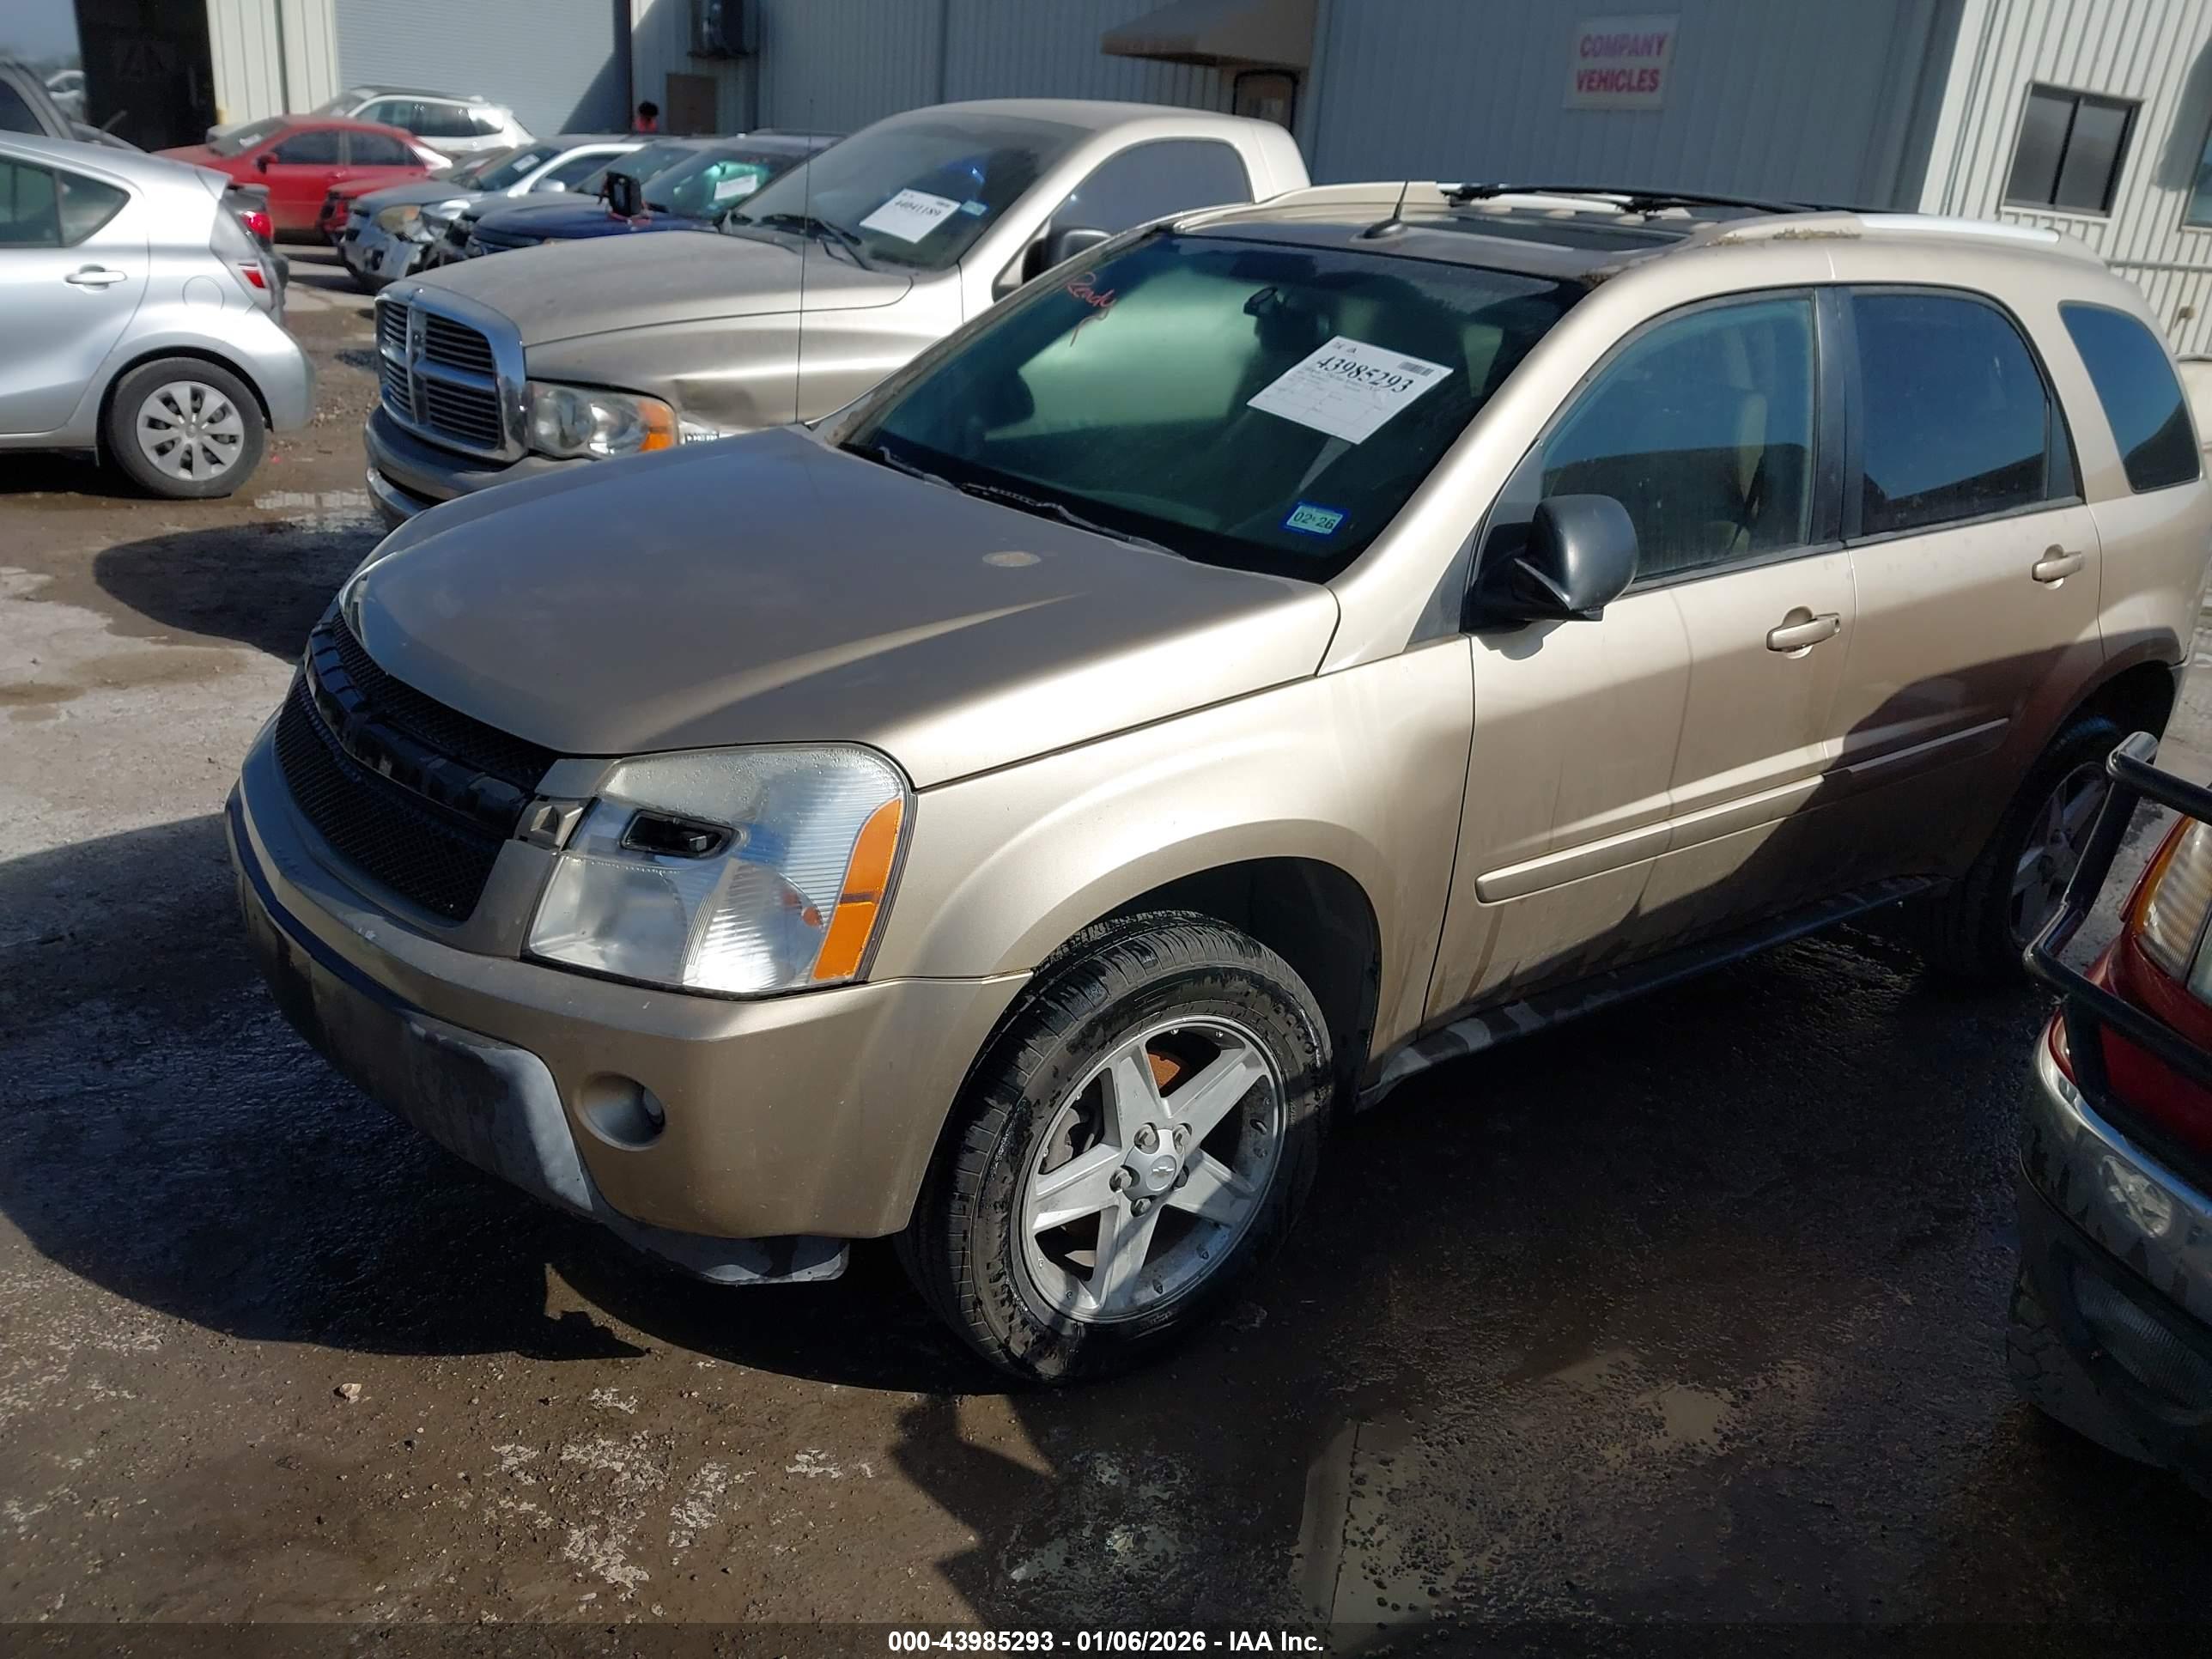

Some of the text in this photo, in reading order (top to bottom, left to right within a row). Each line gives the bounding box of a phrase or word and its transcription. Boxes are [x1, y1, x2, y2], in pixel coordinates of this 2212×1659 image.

[1580, 33, 1668, 58] COMPANY
[1576, 69, 1659, 92] VEHICLES
[1316, 356, 1416, 393] 43985293
